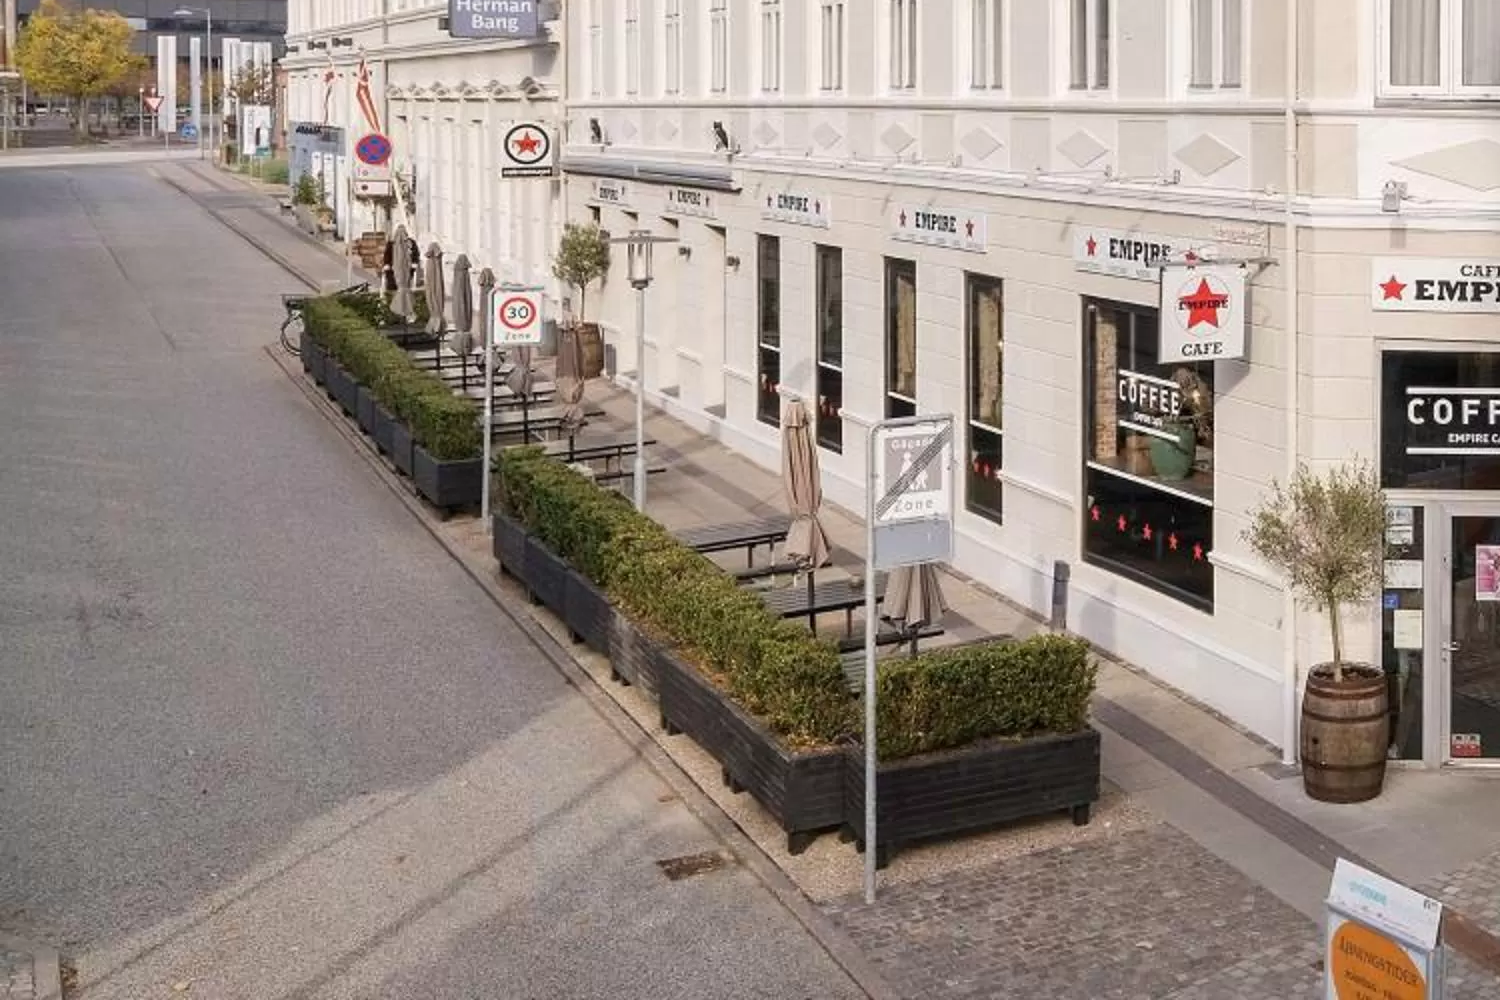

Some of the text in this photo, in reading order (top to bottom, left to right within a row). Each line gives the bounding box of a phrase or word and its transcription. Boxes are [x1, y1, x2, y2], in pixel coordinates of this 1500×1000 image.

[471, 14, 519, 33] Bang
[914, 211, 957, 233] EMPIRE
[1109, 237, 1171, 264] EMPIRE
[507, 305, 529, 319] 30
[1178, 299, 1229, 311] EMPIRE
[1181, 341, 1223, 357] CAFE
[1119, 378, 1180, 416] COFFEE
[1448, 433, 1489, 444] EMPIRE
